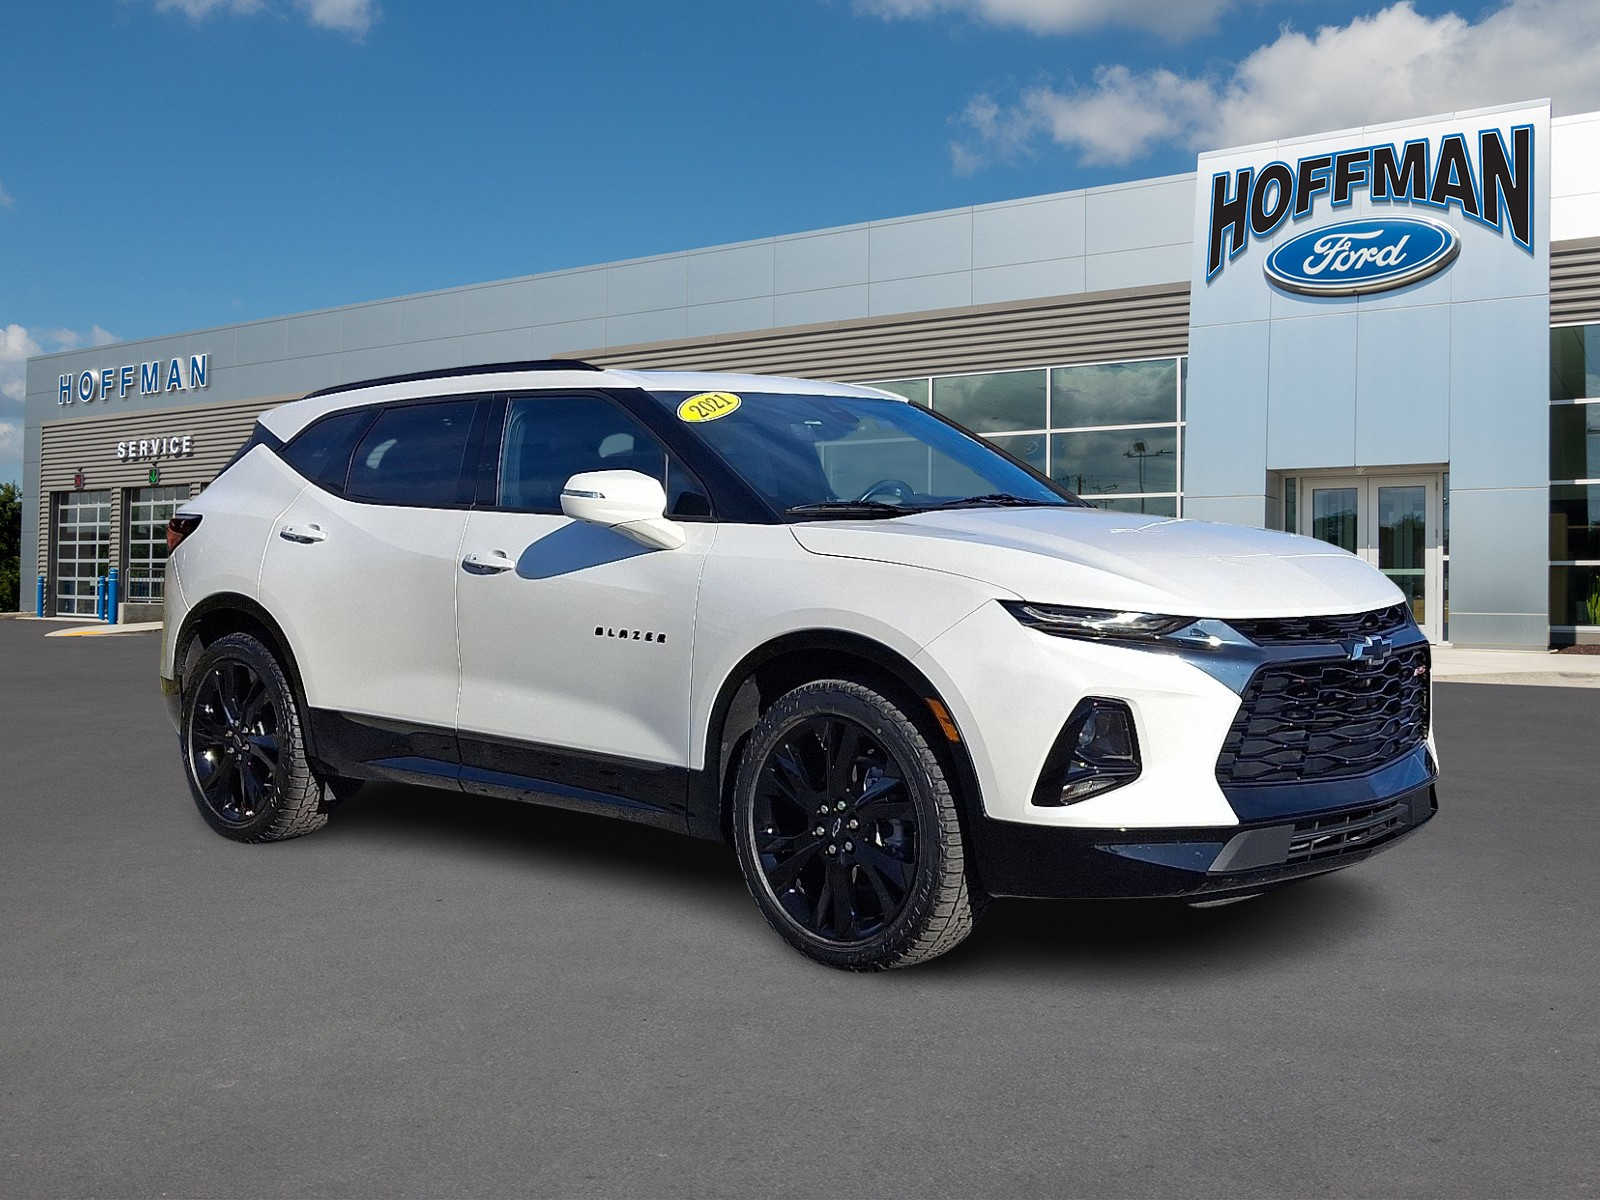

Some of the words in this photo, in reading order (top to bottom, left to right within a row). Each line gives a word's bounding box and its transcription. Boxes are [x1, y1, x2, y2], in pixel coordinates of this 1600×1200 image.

[1206, 123, 1534, 281] HOFFMAN
[1303, 229, 1407, 275] Ford
[58, 354, 208, 405] HOFFMAN
[690, 394, 732, 417] 2021
[117, 436, 192, 458] SERVICE
[594, 626, 666, 643] BLAZER
